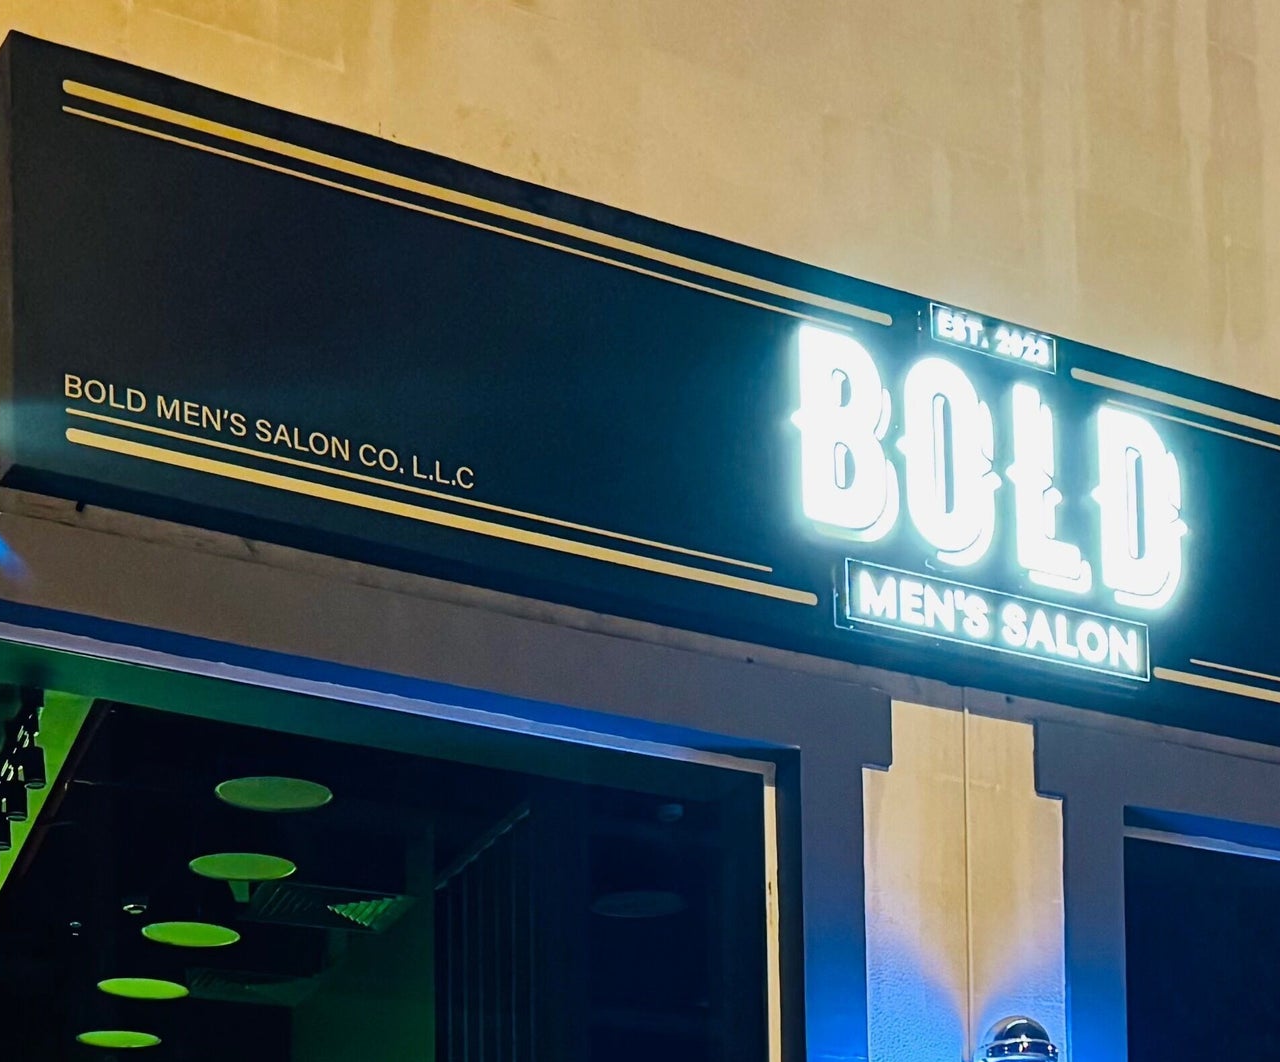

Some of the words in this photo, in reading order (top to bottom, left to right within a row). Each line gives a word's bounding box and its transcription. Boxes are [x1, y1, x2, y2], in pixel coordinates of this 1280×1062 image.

[64, 373, 147, 413] BOLD
[156, 394, 248, 438] MEN'S
[254, 418, 351, 463] SALON
[358, 443, 405, 474] CO.
[412, 455, 476, 491] L.L.C
[790, 325, 1188, 610] BOLD
[858, 570, 991, 639] MEN'S
[1001, 603, 1139, 673] SALON
